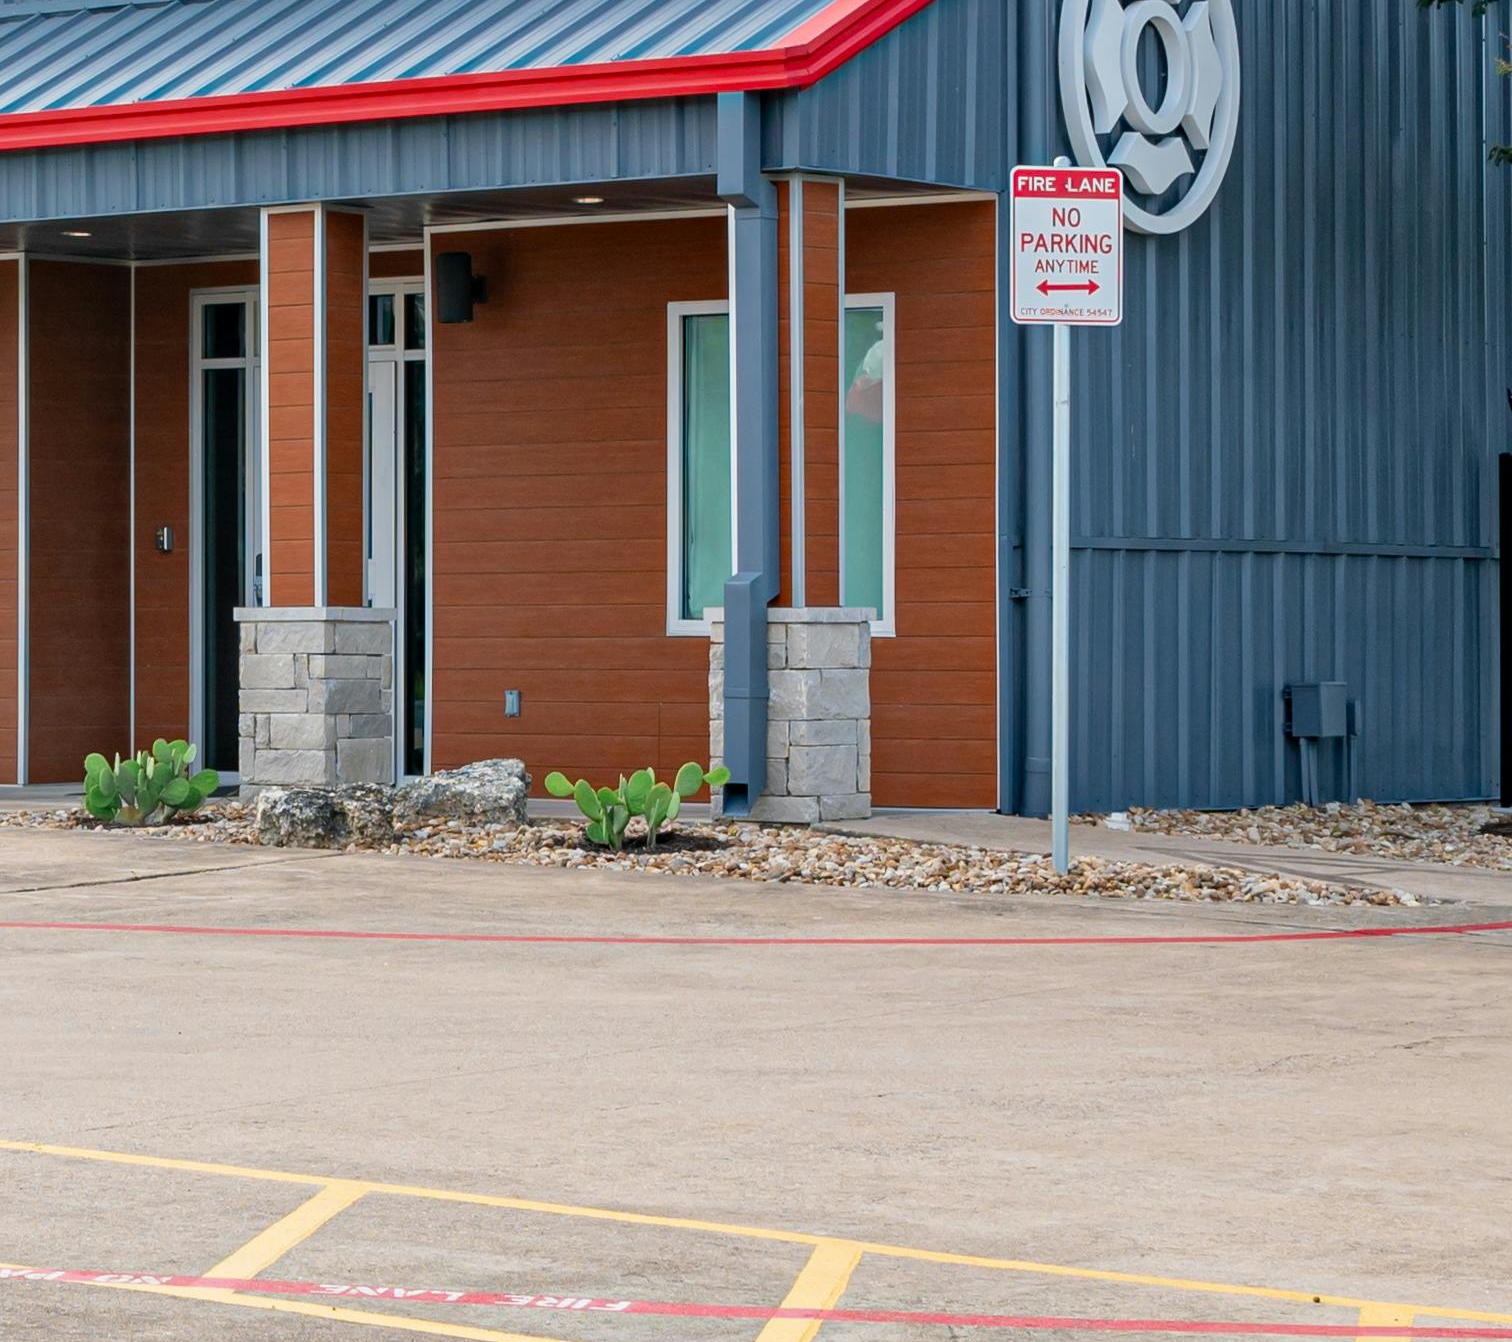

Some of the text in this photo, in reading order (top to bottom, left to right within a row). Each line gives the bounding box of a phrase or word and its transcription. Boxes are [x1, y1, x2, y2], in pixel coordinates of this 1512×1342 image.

[1017, 176, 1116, 193] FIRE LANE
[1052, 207, 1081, 228] NO
[1020, 233, 1112, 254] PARKING
[1034, 259, 1099, 274] ANYTIME
[1020, 307, 1038, 316] CITY
[1039, 307, 1084, 317] ORDINANCE
[92, 1273, 173, 1285] NO
[310, 1283, 465, 1302] LANE
[494, 1294, 632, 1311] FIRE
